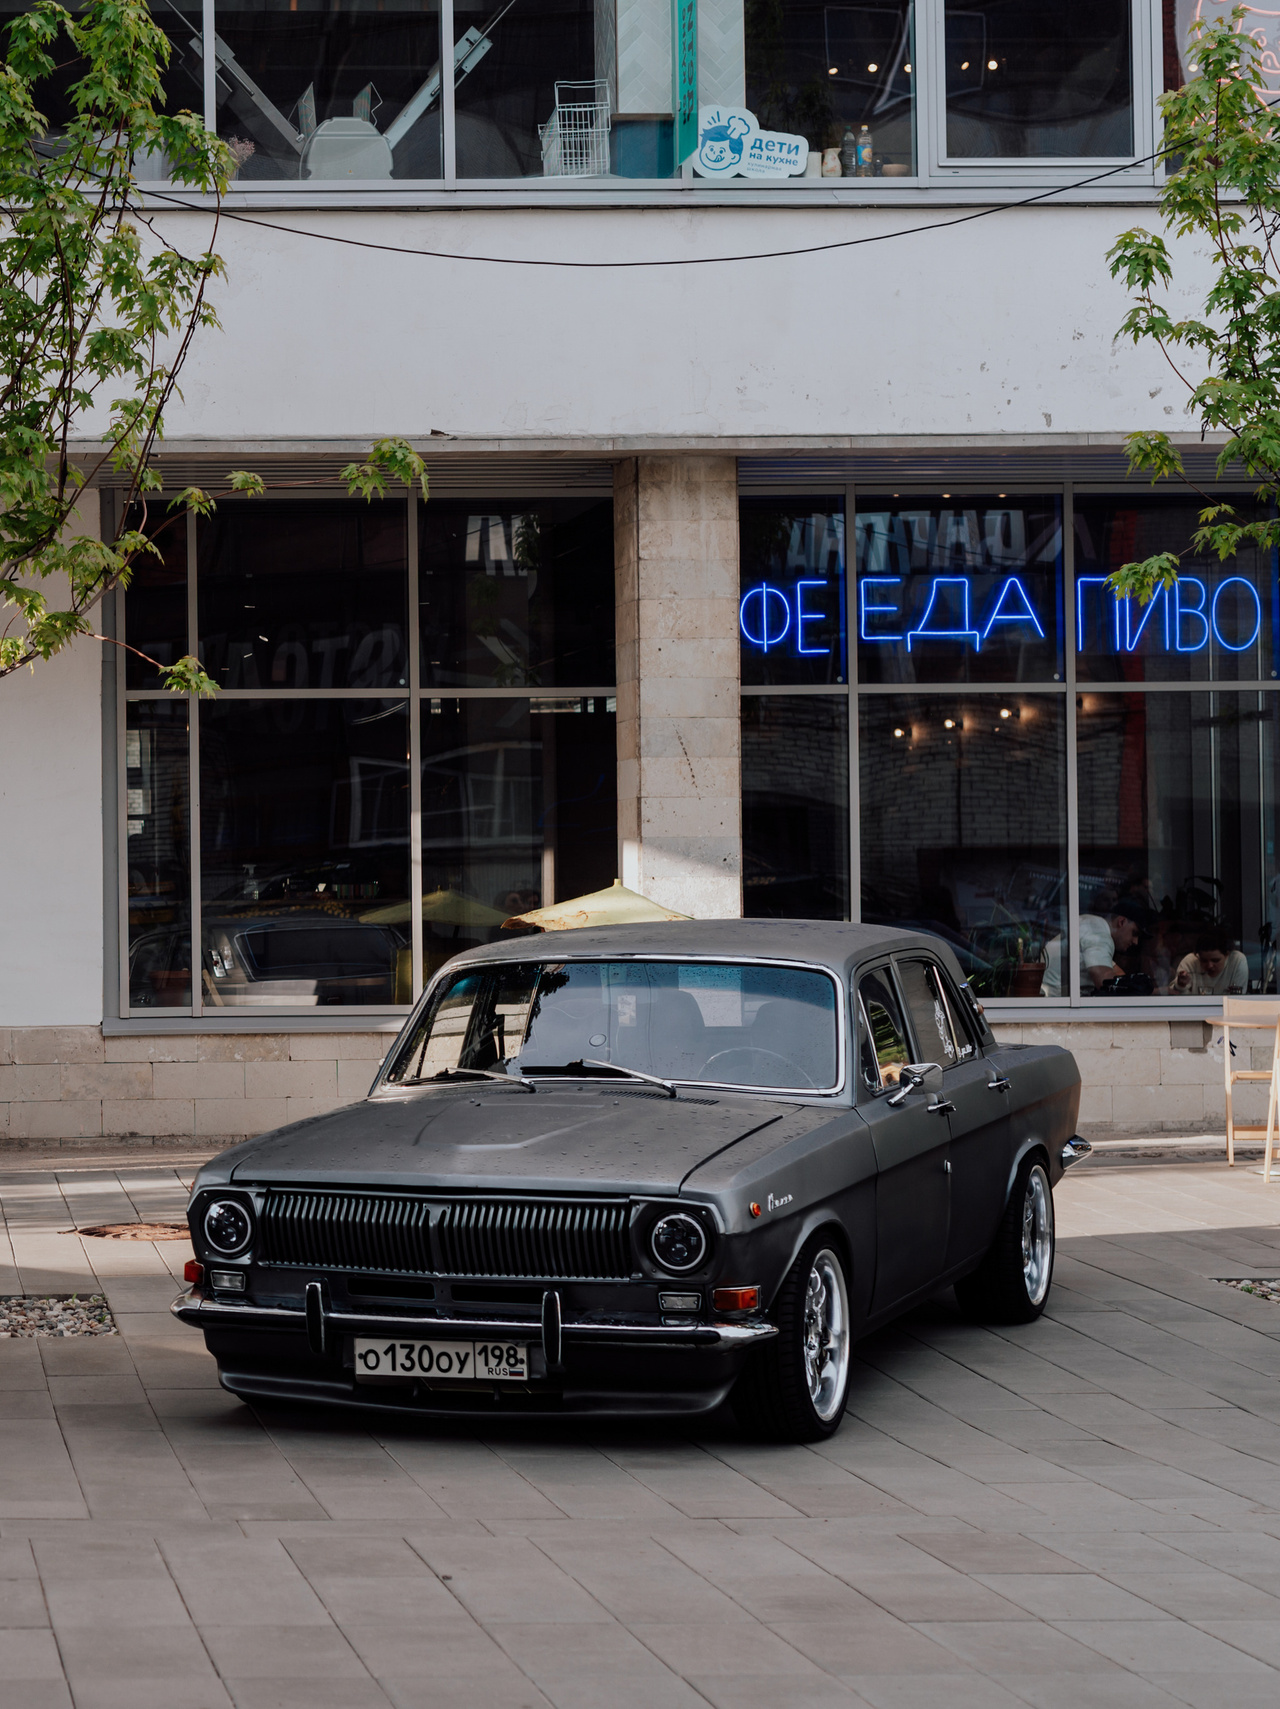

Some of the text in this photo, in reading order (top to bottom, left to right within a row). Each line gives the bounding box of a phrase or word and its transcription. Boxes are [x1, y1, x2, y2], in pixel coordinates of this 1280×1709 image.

[750, 138, 800, 156] дети
[749, 152, 799, 167] на кухне
[739, 576, 1262, 653] ФЕ ЕДА ПИВО
[363, 1343, 519, 1374] О130ОУ 198
[487, 1367, 509, 1376] RUS
